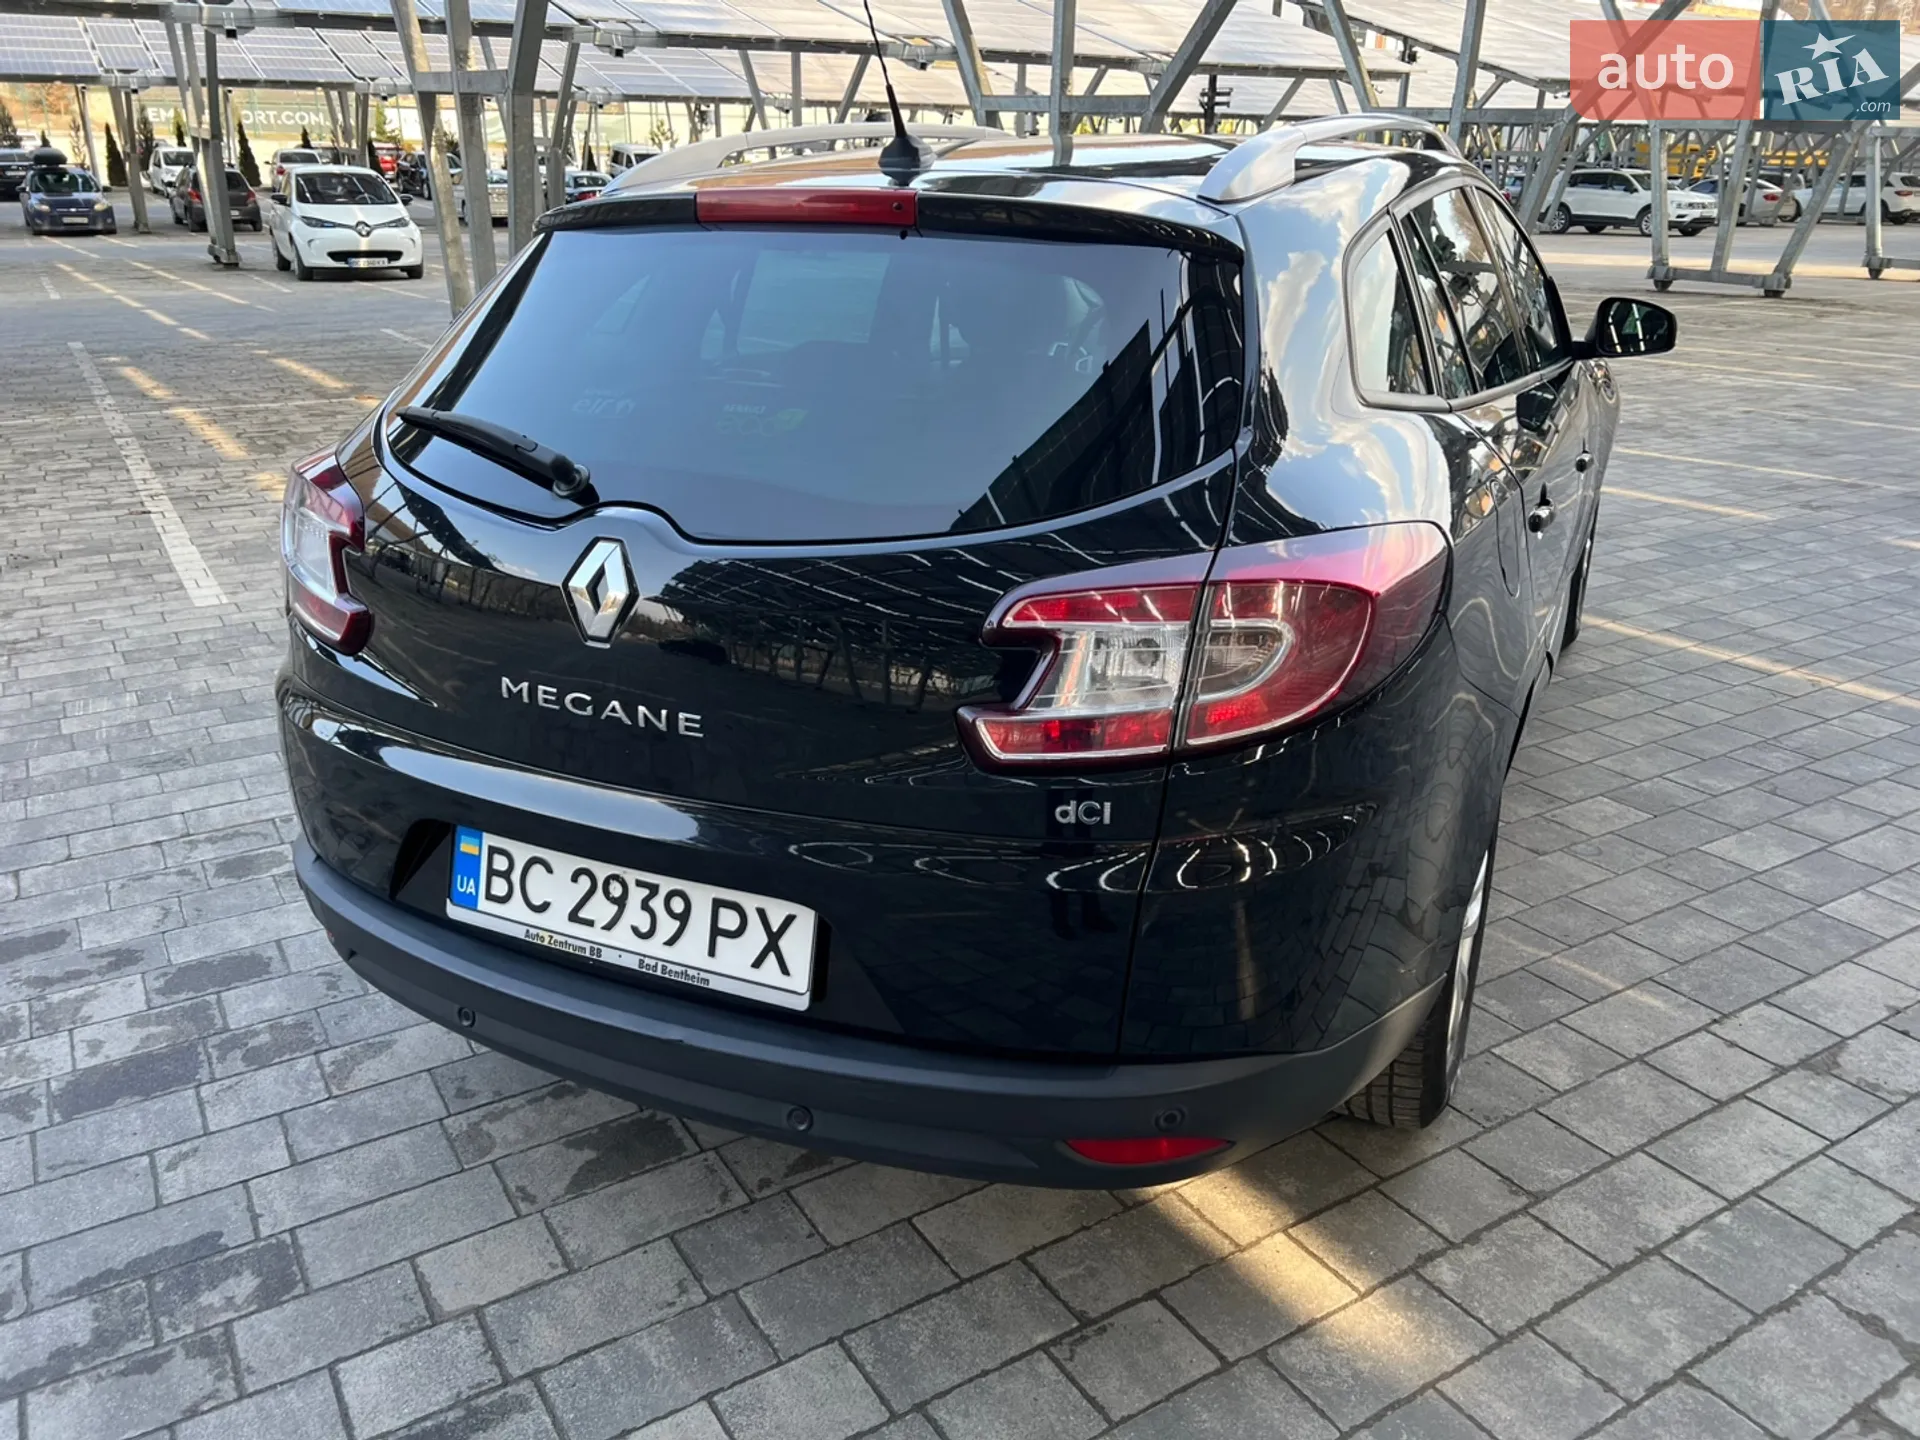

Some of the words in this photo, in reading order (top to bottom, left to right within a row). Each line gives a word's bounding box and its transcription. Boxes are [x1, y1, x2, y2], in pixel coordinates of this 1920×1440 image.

[501, 676, 704, 738] MEGANE
[457, 874, 476, 896] UA
[484, 845, 554, 914] BC
[567, 867, 692, 947] 2939
[706, 897, 797, 976] PX
[524, 929, 546, 944] Auto
[547, 935, 587, 955] Zentrum
[637, 958, 658, 974] Bad
[660, 964, 711, 987] Bentheim
